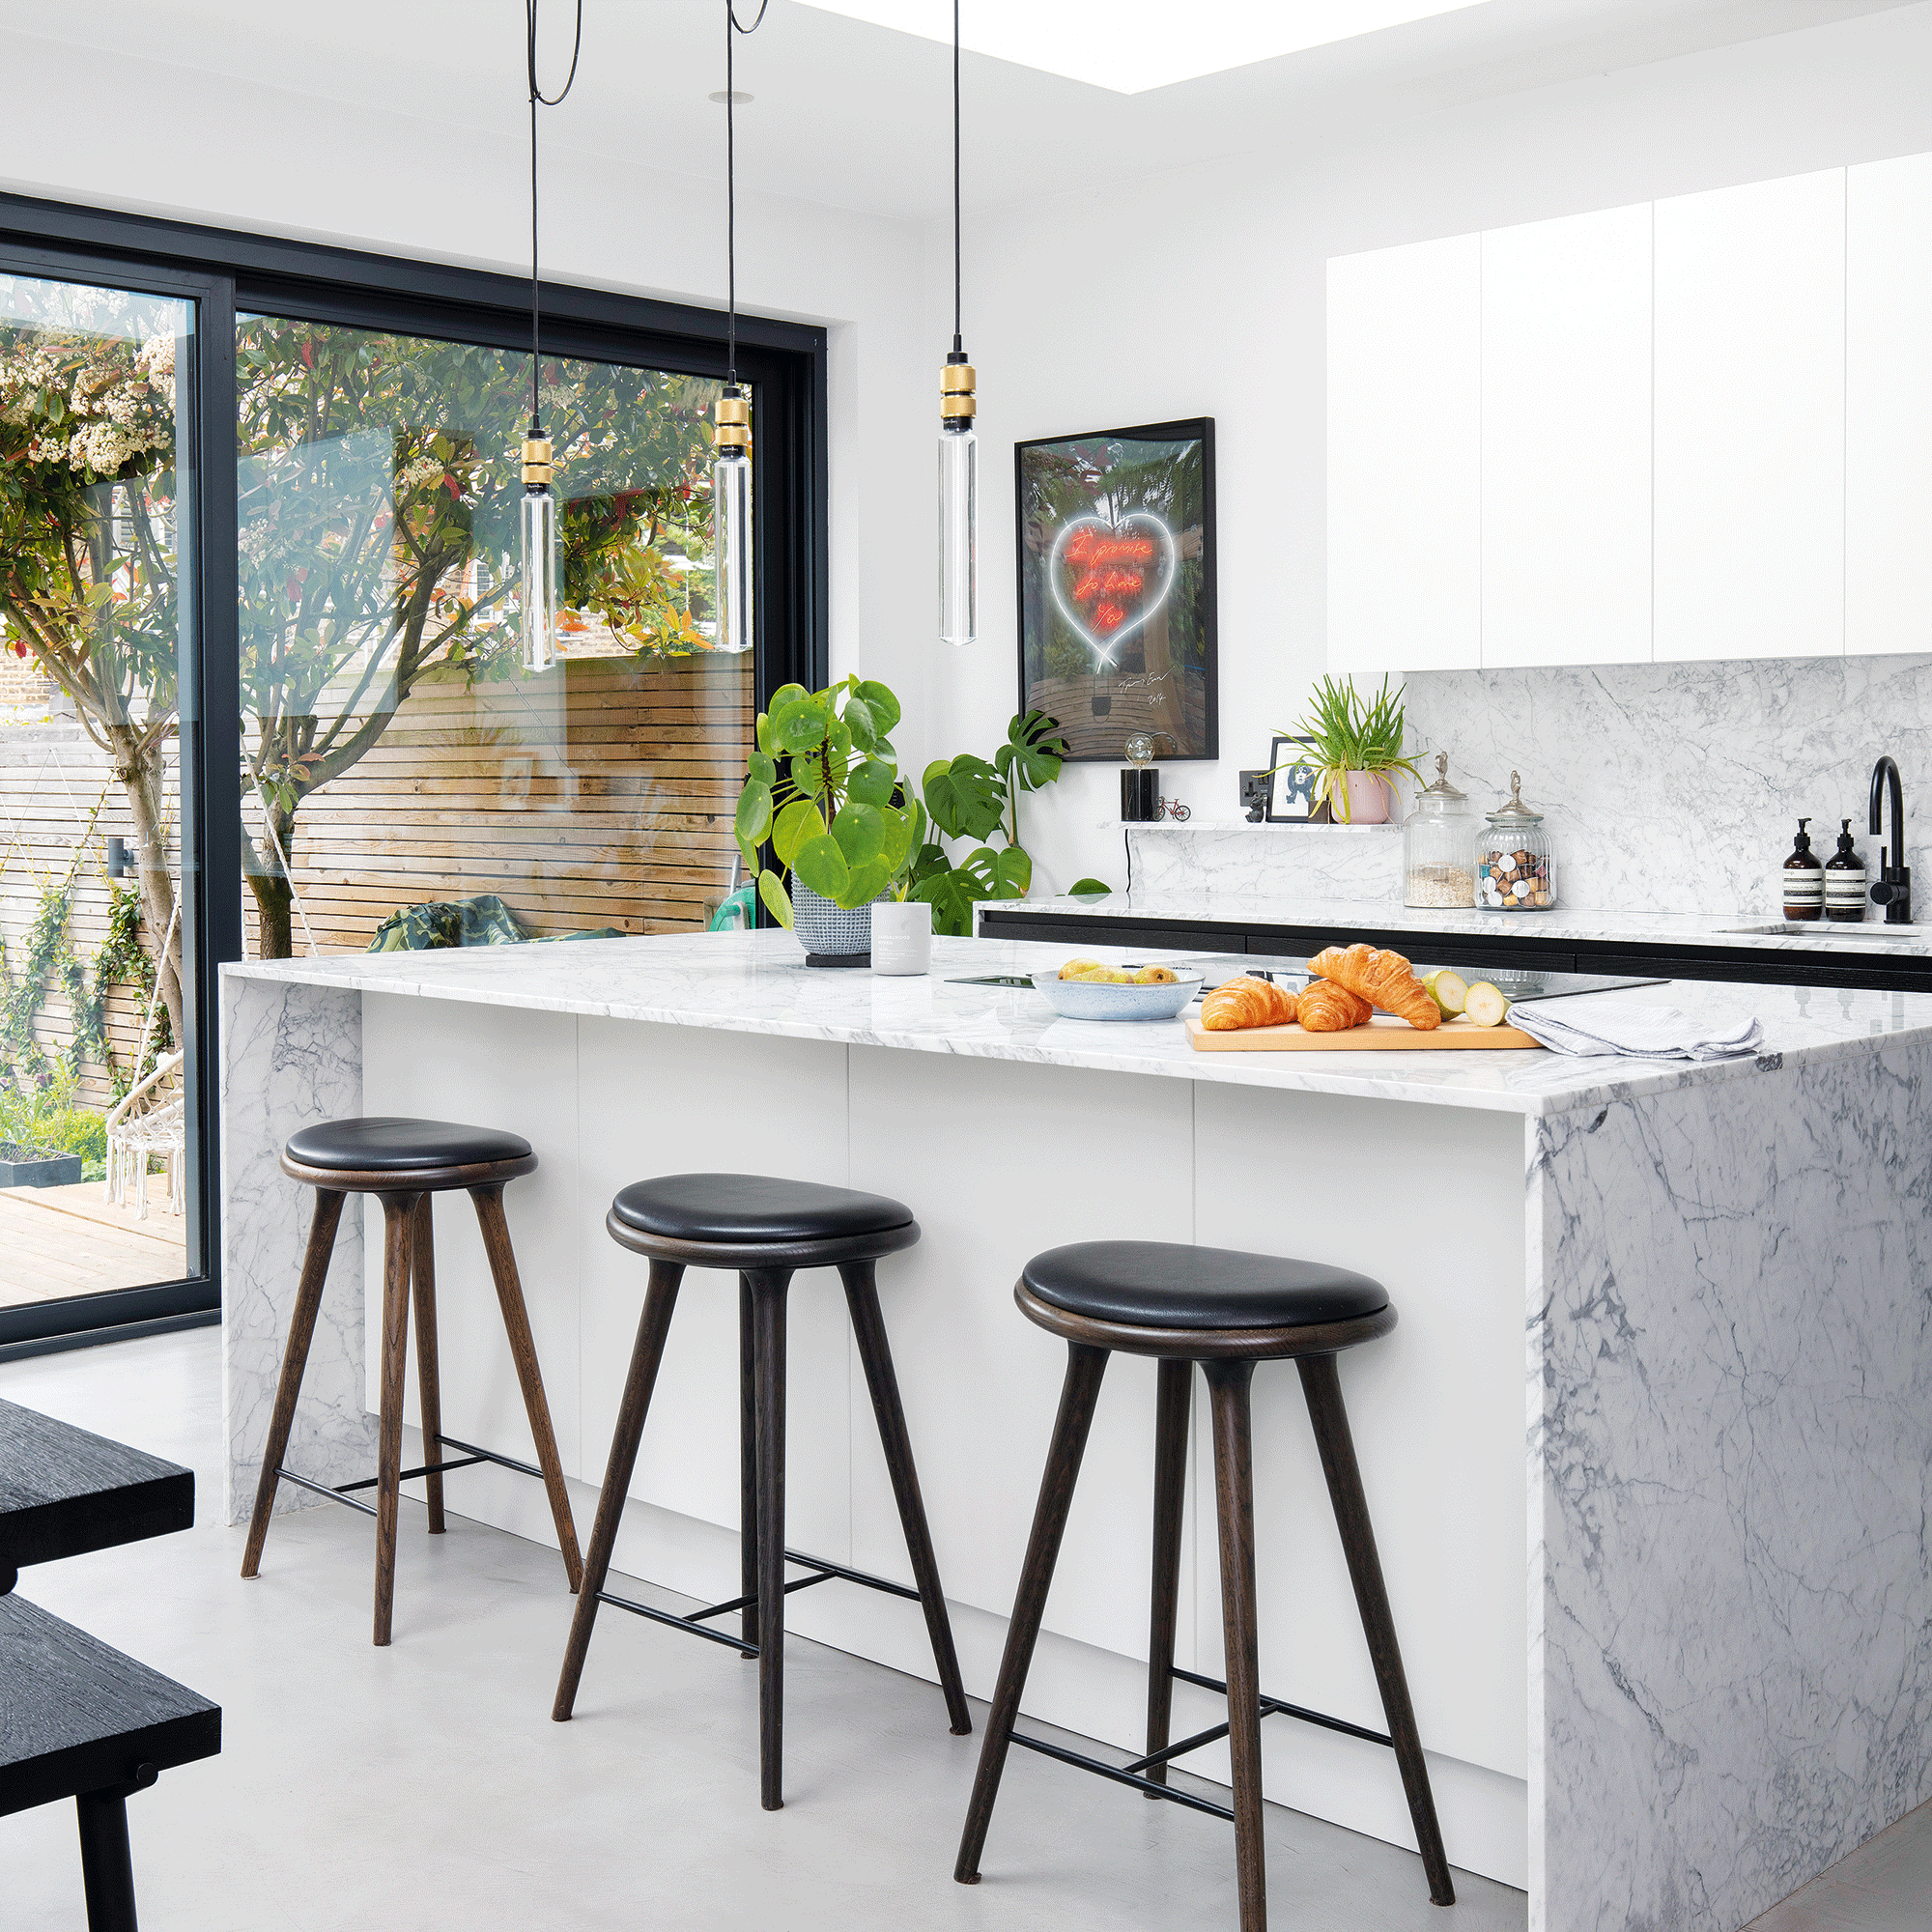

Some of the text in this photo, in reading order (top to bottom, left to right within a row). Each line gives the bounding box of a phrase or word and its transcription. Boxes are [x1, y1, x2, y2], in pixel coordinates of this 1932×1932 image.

[1065, 533, 1153, 566] I promise
[1076, 577, 1098, 596] to
